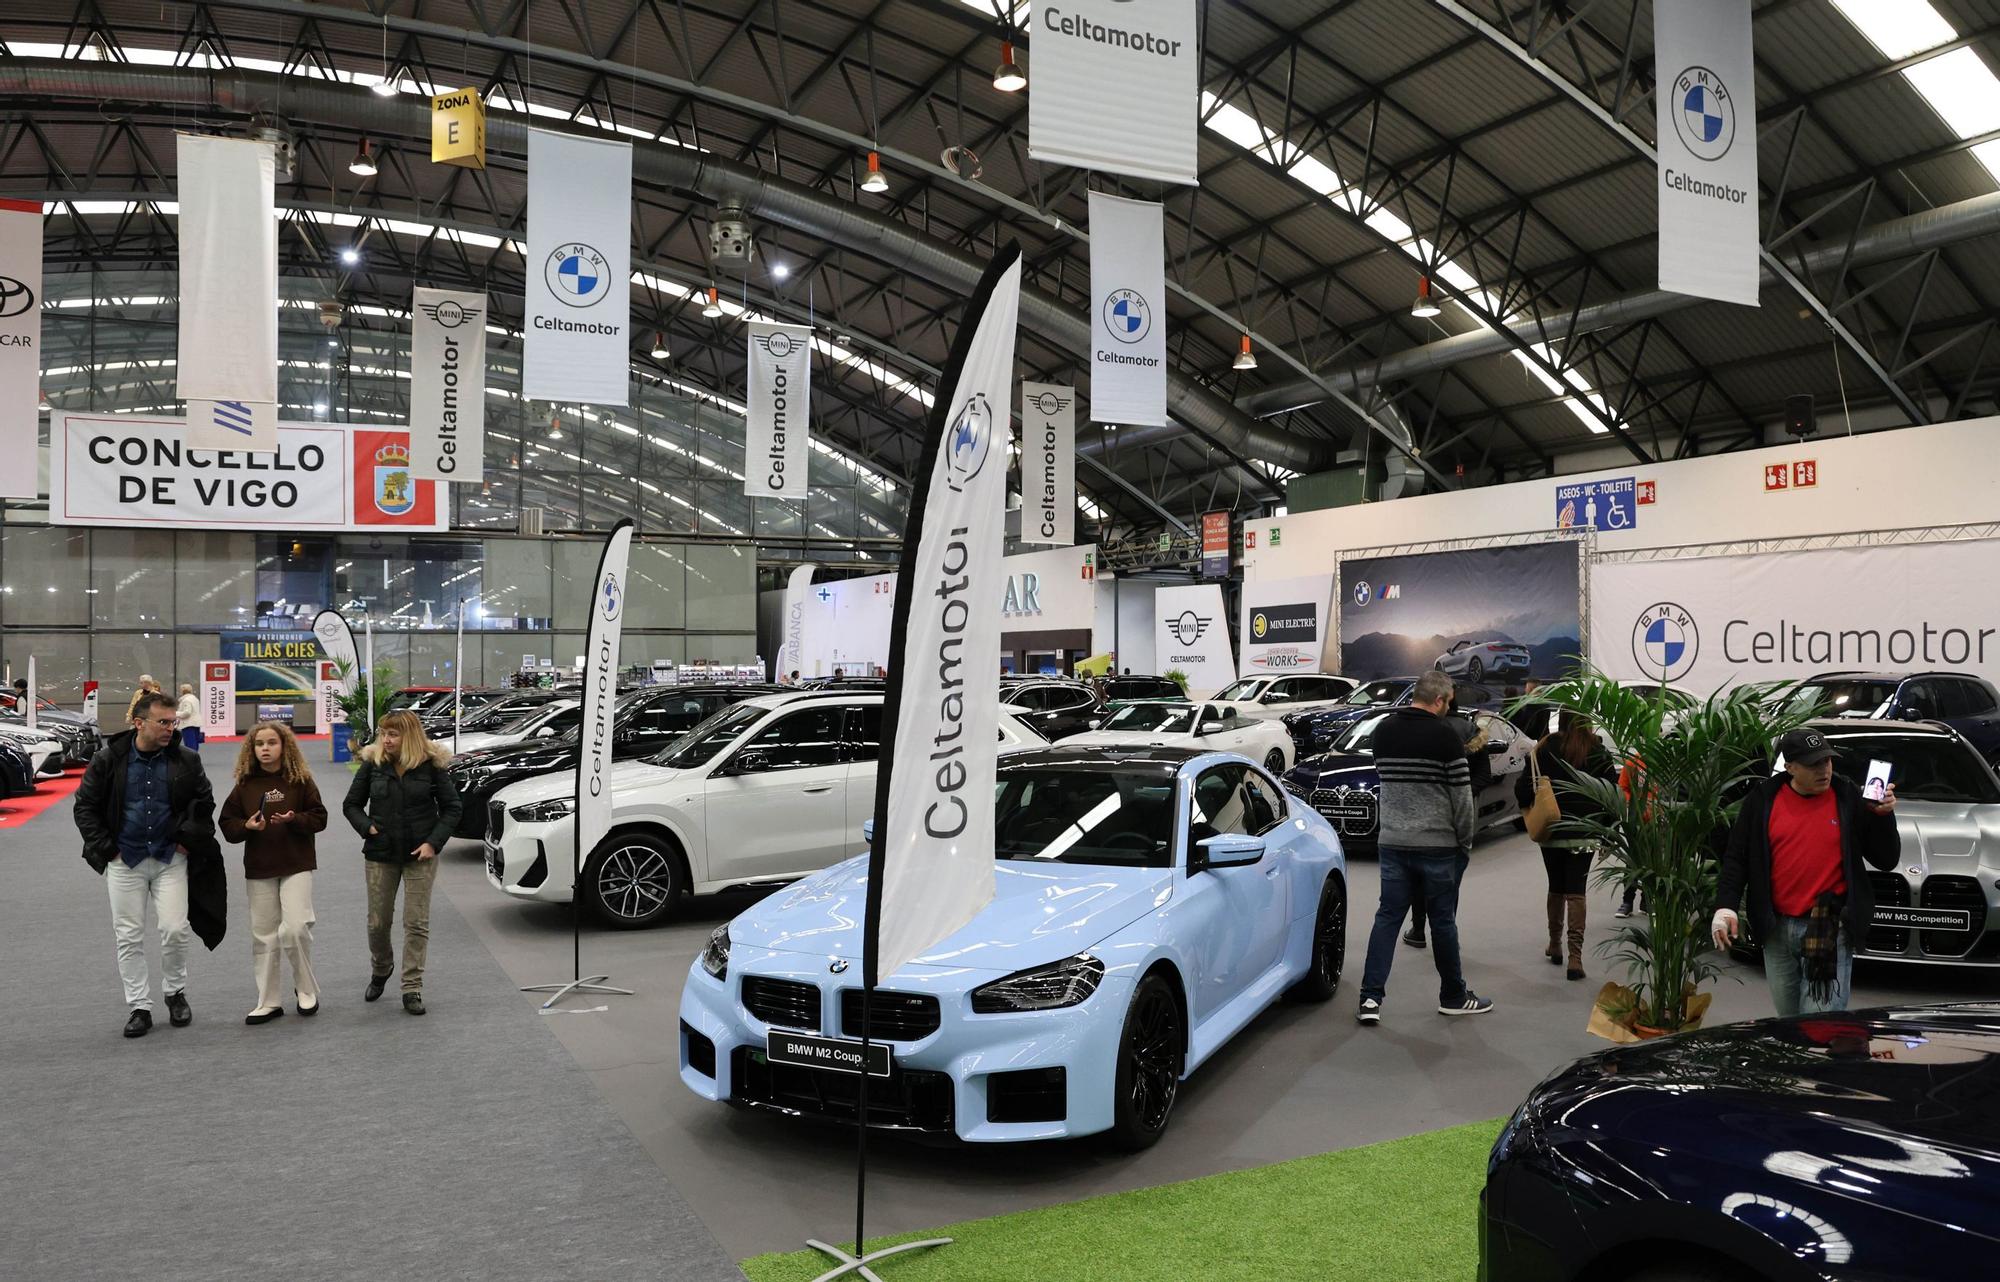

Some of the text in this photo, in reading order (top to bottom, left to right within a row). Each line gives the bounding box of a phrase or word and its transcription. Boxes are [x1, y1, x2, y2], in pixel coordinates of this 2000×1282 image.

[1044, 6, 1181, 57] Celtamotor
[1679, 71, 1727, 101] BMW
[437, 94, 470, 111] ZONA
[448, 120, 459, 144] E
[1665, 168, 1748, 204] Celtamotor
[554, 246, 603, 266] BMW
[1109, 291, 1145, 308] BMW
[439, 309, 461, 319] MINI
[533, 315, 620, 335] Celtamotor
[770, 340, 789, 350] MINI
[1097, 350, 1159, 367] Celtamotor
[437, 335, 459, 474] Celtamotor
[1040, 400, 1057, 408] MINI
[768, 364, 787, 491] Celtamotor
[88, 435, 325, 472] CONCELLO
[1040, 421, 1056, 538] Celtamotor
[119, 475, 298, 508] DE VIGO
[1558, 480, 1633, 500] ASEOS WC TOILETTE
[1269, 617, 1316, 629] MINI ELECTRIC
[1640, 606, 1690, 628] BMW
[1180, 623, 1197, 634] MINI
[244, 642, 315, 658] ILLAS CIES
[1723, 619, 1997, 664] Celtamotor
[1170, 655, 1206, 663] CELTAMOTOR
[1267, 655, 1298, 666] WORKS
[218, 708, 225, 720] DE
[590, 633, 611, 797] Celtamotor
[1894, 913, 1909, 921] M3
[1910, 914, 1964, 924] Competition
[787, 1042, 864, 1066] BMW M2 Coup
